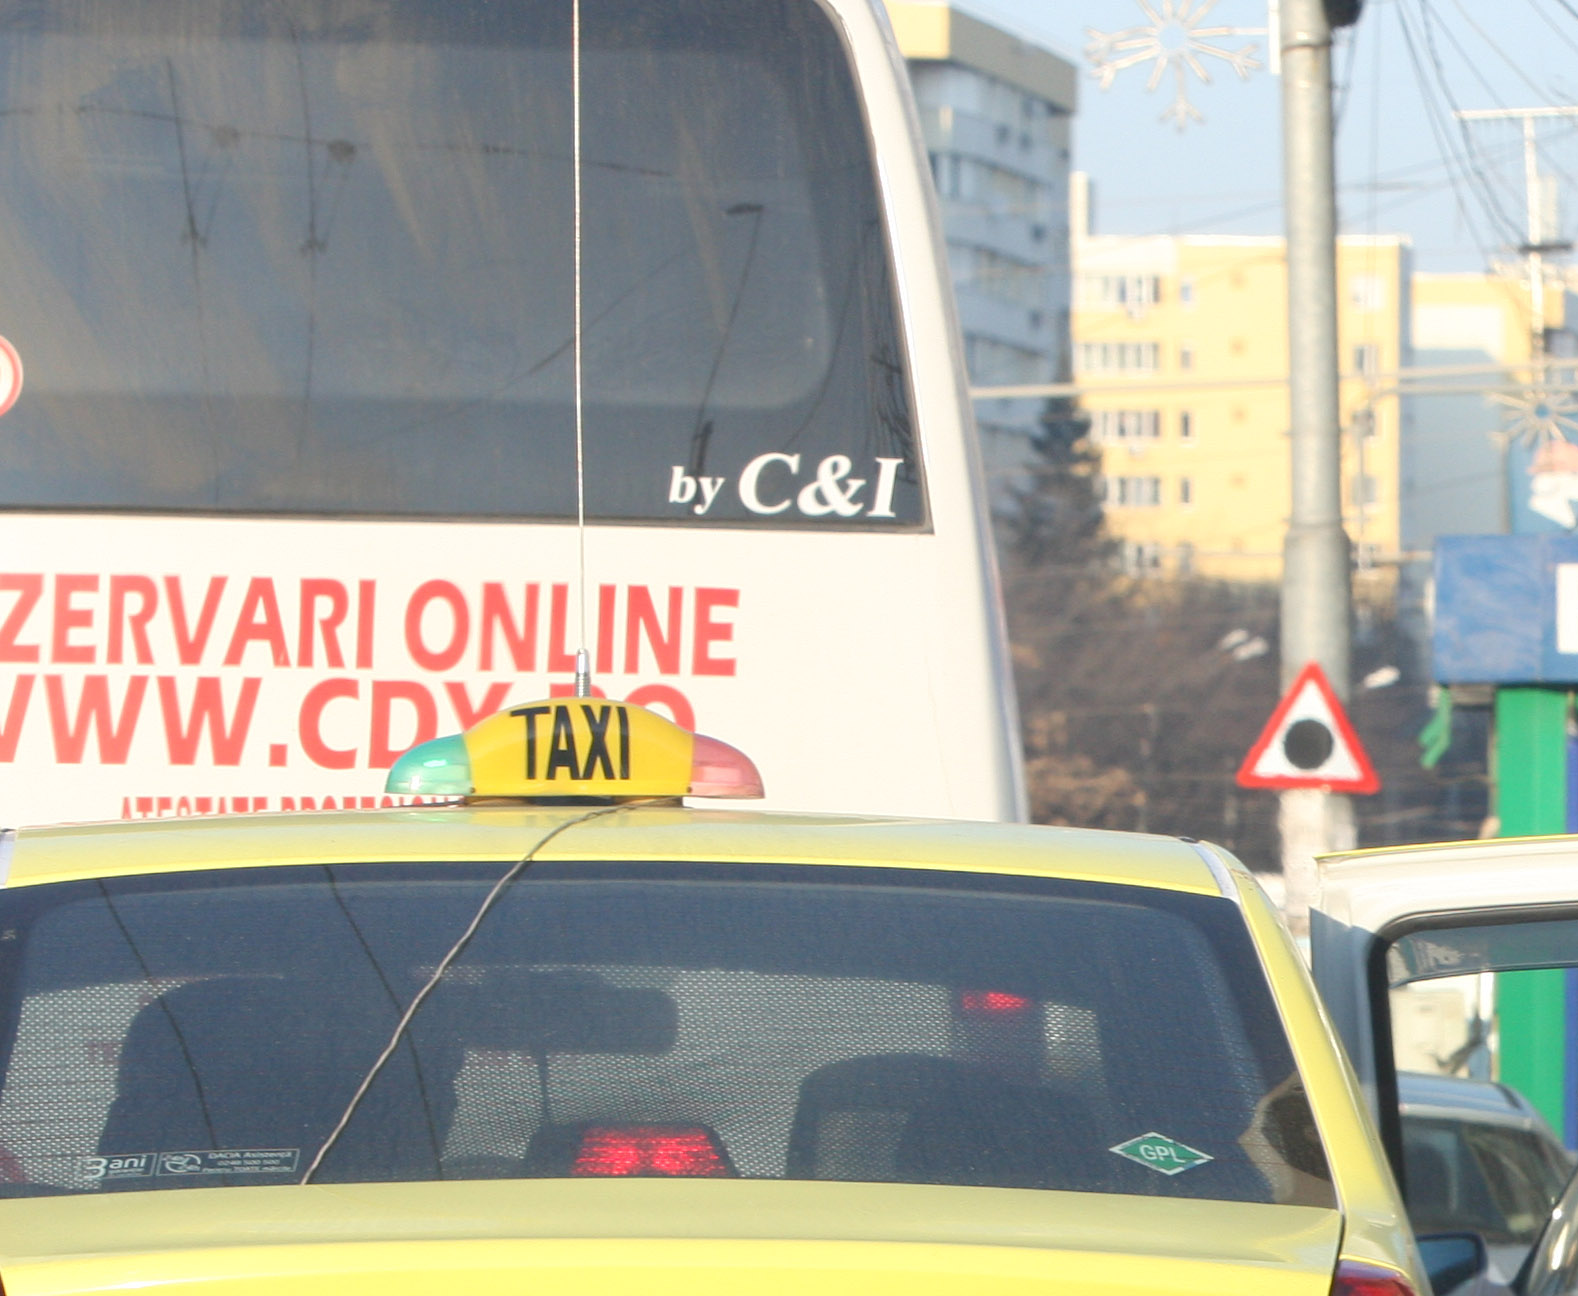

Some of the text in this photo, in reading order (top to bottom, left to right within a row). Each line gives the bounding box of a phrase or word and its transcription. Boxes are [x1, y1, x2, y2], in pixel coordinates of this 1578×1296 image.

[667, 451, 904, 519] by C&I
[0, 572, 741, 677] ZERVARI ONLINE
[510, 704, 630, 781] TAXI
[1138, 1144, 1187, 1164] GPL
